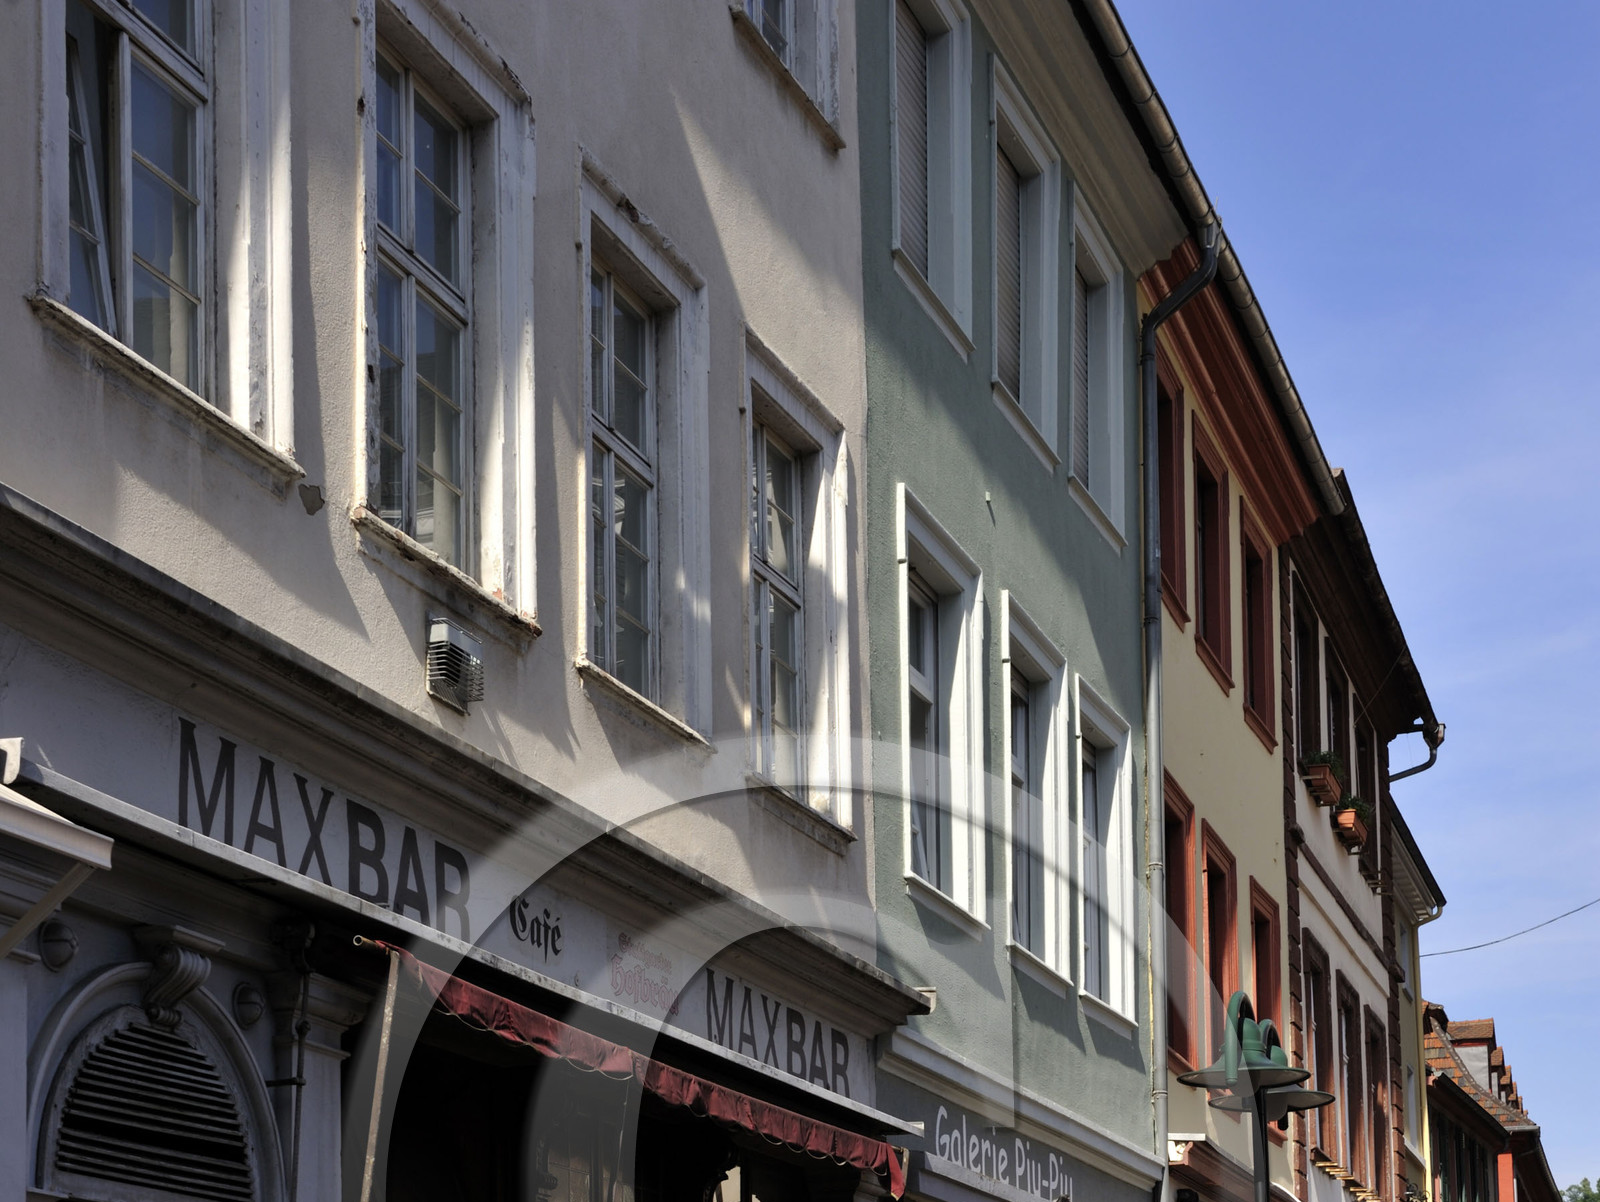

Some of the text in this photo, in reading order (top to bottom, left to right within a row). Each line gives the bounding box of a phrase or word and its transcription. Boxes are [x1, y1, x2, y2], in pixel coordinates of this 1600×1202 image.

[178, 716, 471, 946] MAXBAR
[508, 896, 563, 964] Café
[705, 967, 850, 1099] MAXBAR
[935, 1105, 1010, 1185] Galerie
